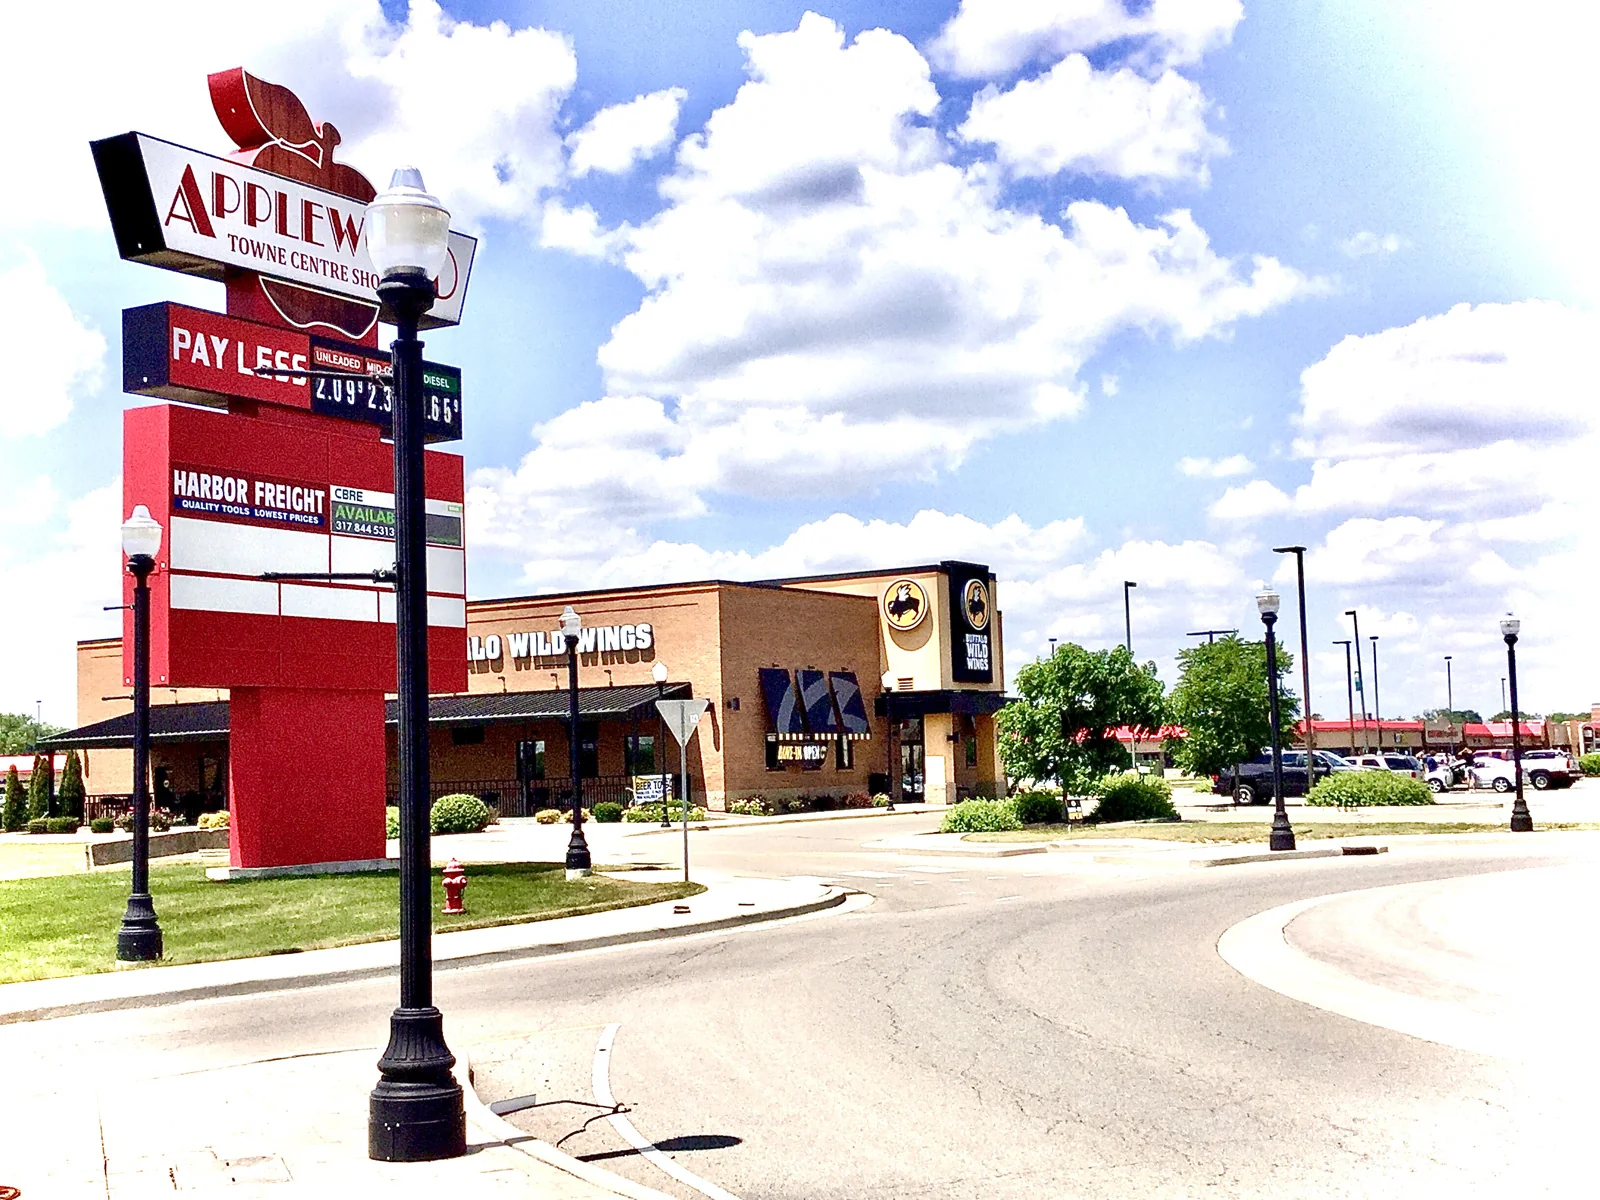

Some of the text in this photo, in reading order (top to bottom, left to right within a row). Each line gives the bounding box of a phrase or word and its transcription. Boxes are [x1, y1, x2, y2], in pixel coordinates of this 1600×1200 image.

[227, 233, 381, 291] TOWNE CENTRE SHO
[173, 327, 307, 386] PAY LESS
[315, 350, 450, 389] UNLEADED MID-G DIESEL
[367, 381, 392, 412] 2.3
[173, 469, 325, 514] HARBOR FREIGHT
[334, 488, 363, 502] CBRE
[182, 499, 319, 524] QUALITY TOOLS LOWEST PRICES
[335, 504, 395, 525] AVAILAB
[335, 520, 395, 537] 317 844 5313
[506, 630, 568, 658] WILD
[578, 623, 652, 653] WINGS
[966, 643, 989, 659] WILD
[966, 657, 989, 671] WINGS
